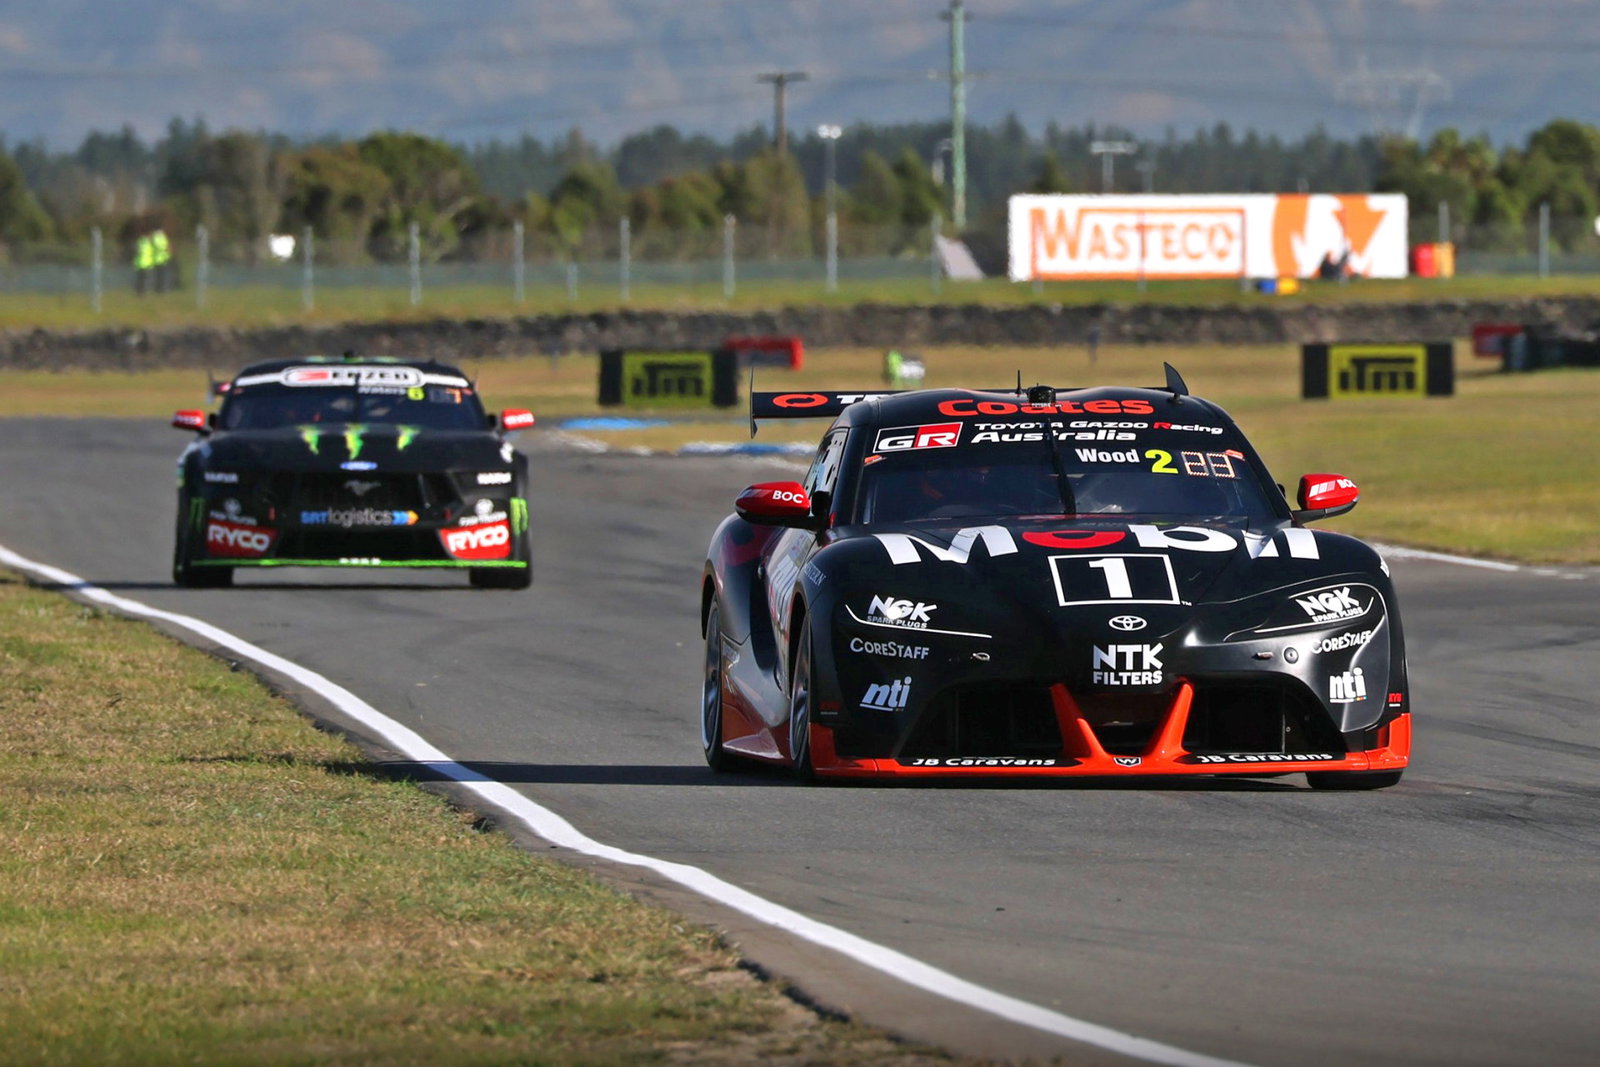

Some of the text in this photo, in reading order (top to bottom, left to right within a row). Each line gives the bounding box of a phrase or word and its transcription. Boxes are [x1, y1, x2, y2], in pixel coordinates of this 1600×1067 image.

[1029, 207, 1236, 261] WASTECO
[407, 386, 424, 400] 6
[938, 399, 1154, 417] Coates
[877, 428, 958, 451] GR
[974, 420, 1223, 435] TOYOTA GAZOO Racing
[1075, 449, 1140, 464] Wood
[1145, 449, 1179, 474] 2
[772, 489, 804, 504] BOC
[207, 524, 271, 552] RYCO
[446, 525, 510, 552] RYCO
[872, 524, 1319, 565] Mobil
[1088, 557, 1133, 598] 1
[867, 594, 938, 622] NGK
[1295, 586, 1360, 616] NGK
[866, 615, 928, 629] SPARK PLUGS
[1311, 606, 1364, 622] SPARK PLUGS
[1093, 642, 1164, 670] NTK
[1093, 670, 1163, 686] FILTERS
[1329, 667, 1367, 700] nti
[861, 676, 912, 709] nti
[912, 758, 1057, 766] JB Caravans
[1197, 753, 1333, 763] JB Caravans
